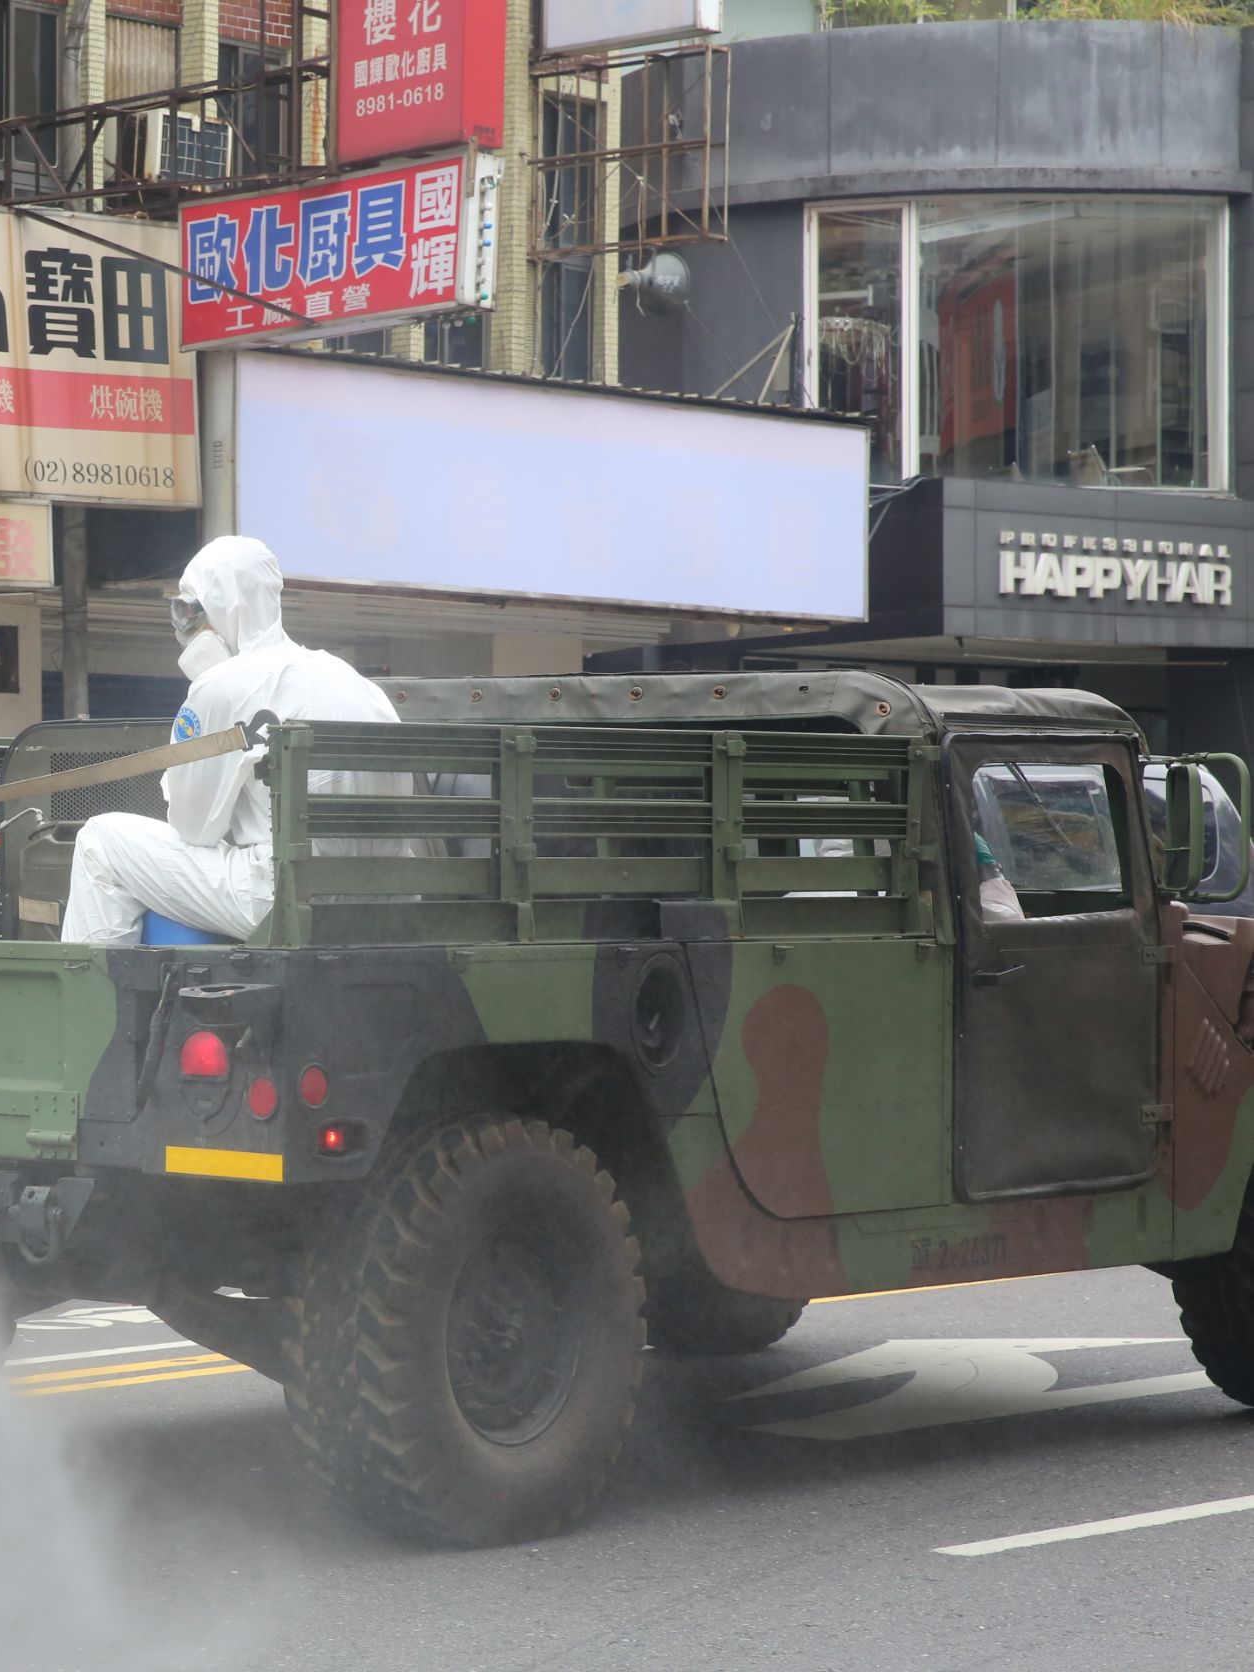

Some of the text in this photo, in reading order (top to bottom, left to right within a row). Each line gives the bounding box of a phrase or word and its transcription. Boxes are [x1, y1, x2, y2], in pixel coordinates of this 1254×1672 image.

[356, 82, 444, 117] 8981-0618
[409, 164, 459, 299] 國輝
[24, 247, 170, 365] 寶田
[224, 283, 372, 332] 工廠直營
[89, 385, 164, 423] 烘碗機
[25, 456, 176, 489] (02)89810618
[999, 530, 1231, 558] PROFESSIONAL
